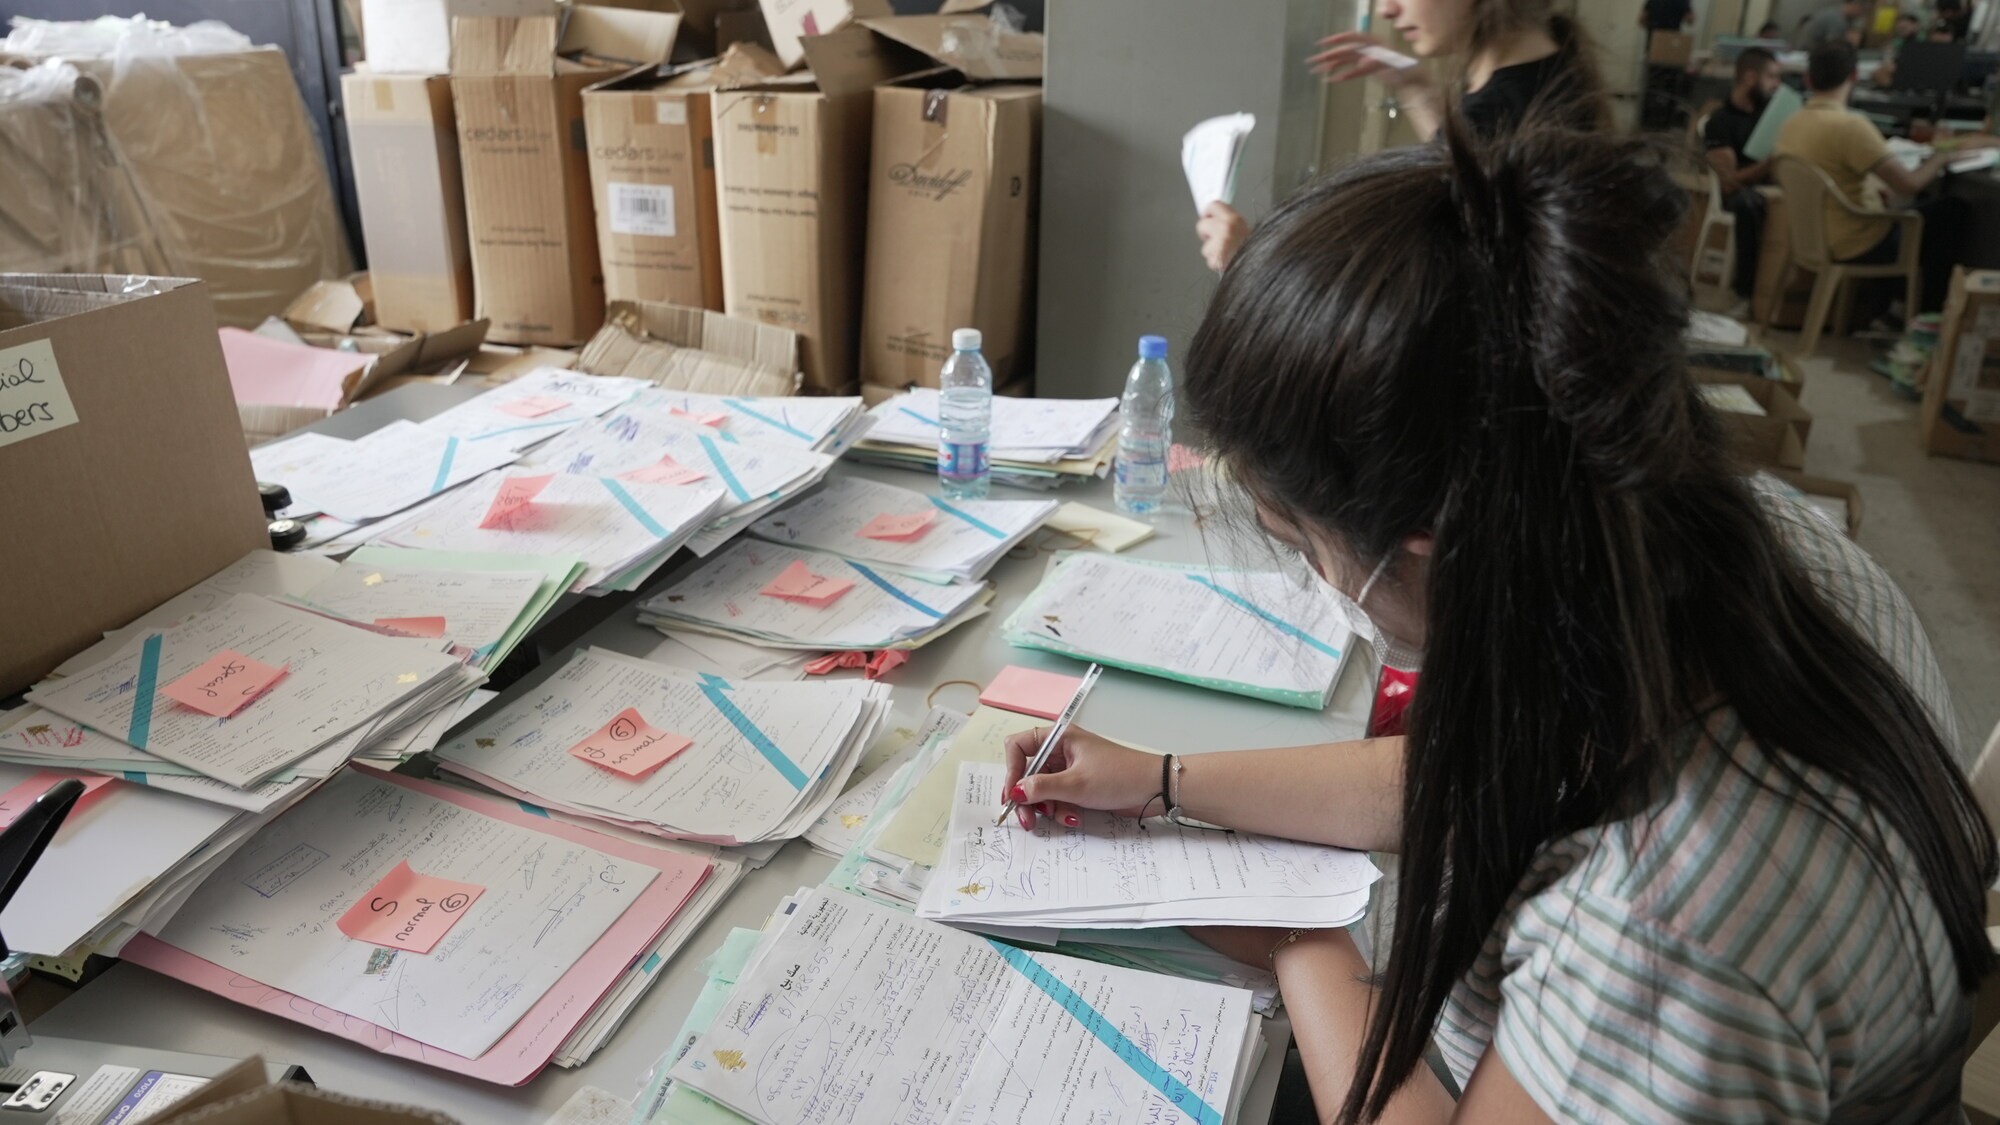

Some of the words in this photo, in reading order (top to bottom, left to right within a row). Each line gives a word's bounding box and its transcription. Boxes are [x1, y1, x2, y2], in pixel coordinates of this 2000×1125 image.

[595, 141, 655, 161] cedars
[888, 162, 973, 202] Davidoff
[0, 358, 45, 391] ial
[0, 402, 54, 432] bers
[370, 896, 398, 917] S
[395, 898, 435, 941] normal
[784, 961, 800, 978] صك
[779, 976, 794, 991] بيع
